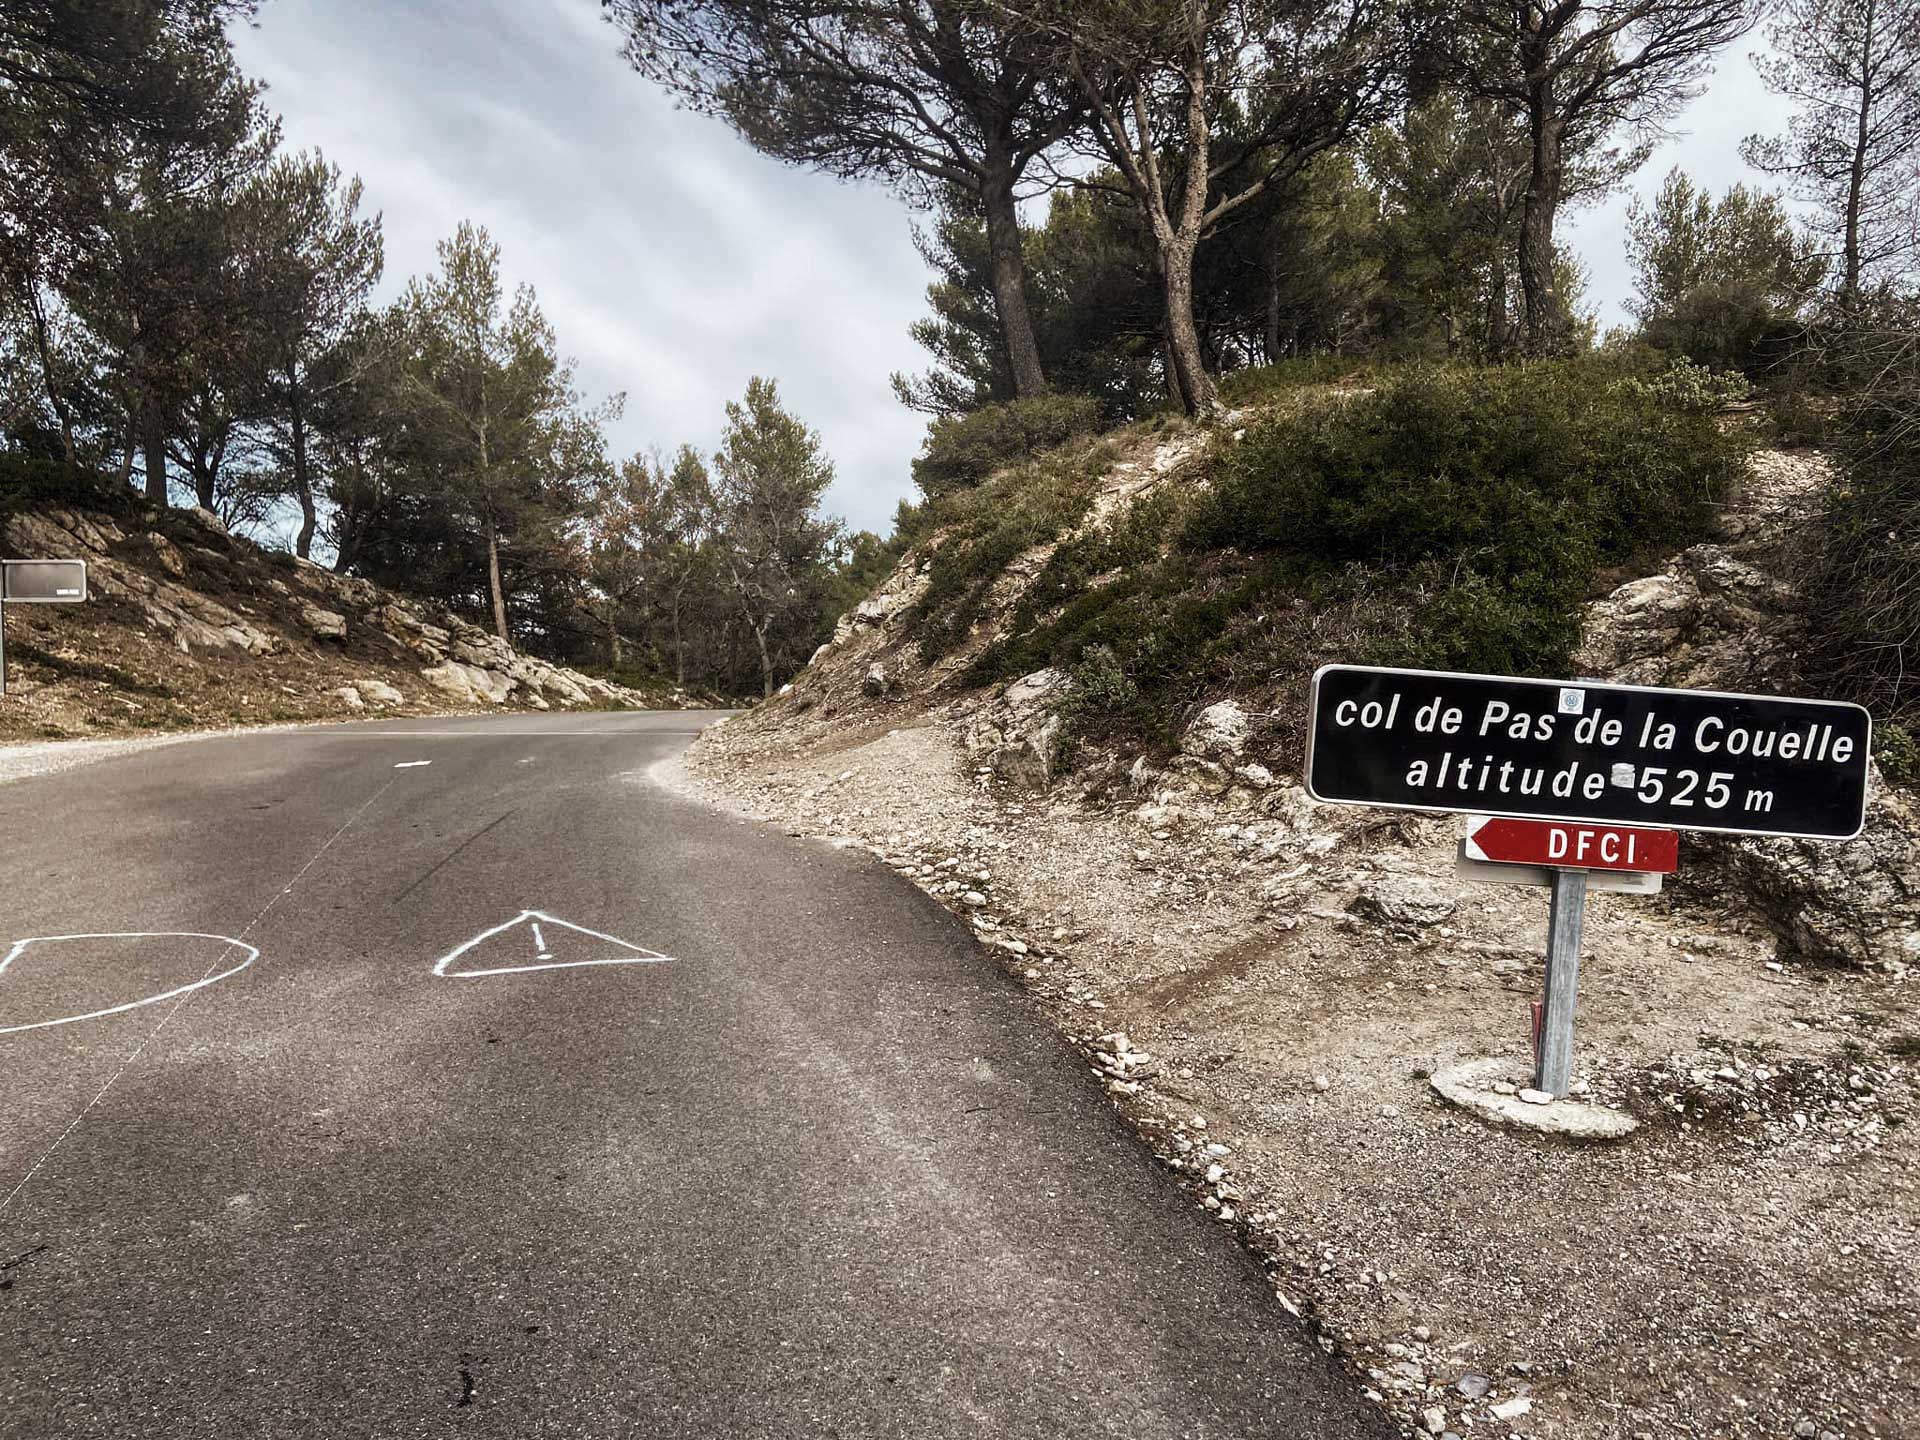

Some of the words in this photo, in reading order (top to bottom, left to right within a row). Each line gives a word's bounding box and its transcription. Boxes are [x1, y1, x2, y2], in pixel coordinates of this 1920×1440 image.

[1335, 693, 1401, 730] col
[1414, 696, 1463, 734] de
[1479, 700, 1556, 742] Pas
[1574, 708, 1623, 747] de
[1638, 712, 1676, 751] la
[1694, 716, 1854, 763] Couelle
[1405, 752, 1606, 801] altitude
[1637, 766, 1735, 809] 525
[1744, 789, 1774, 812] m
[1548, 828, 1636, 864] DFCI
